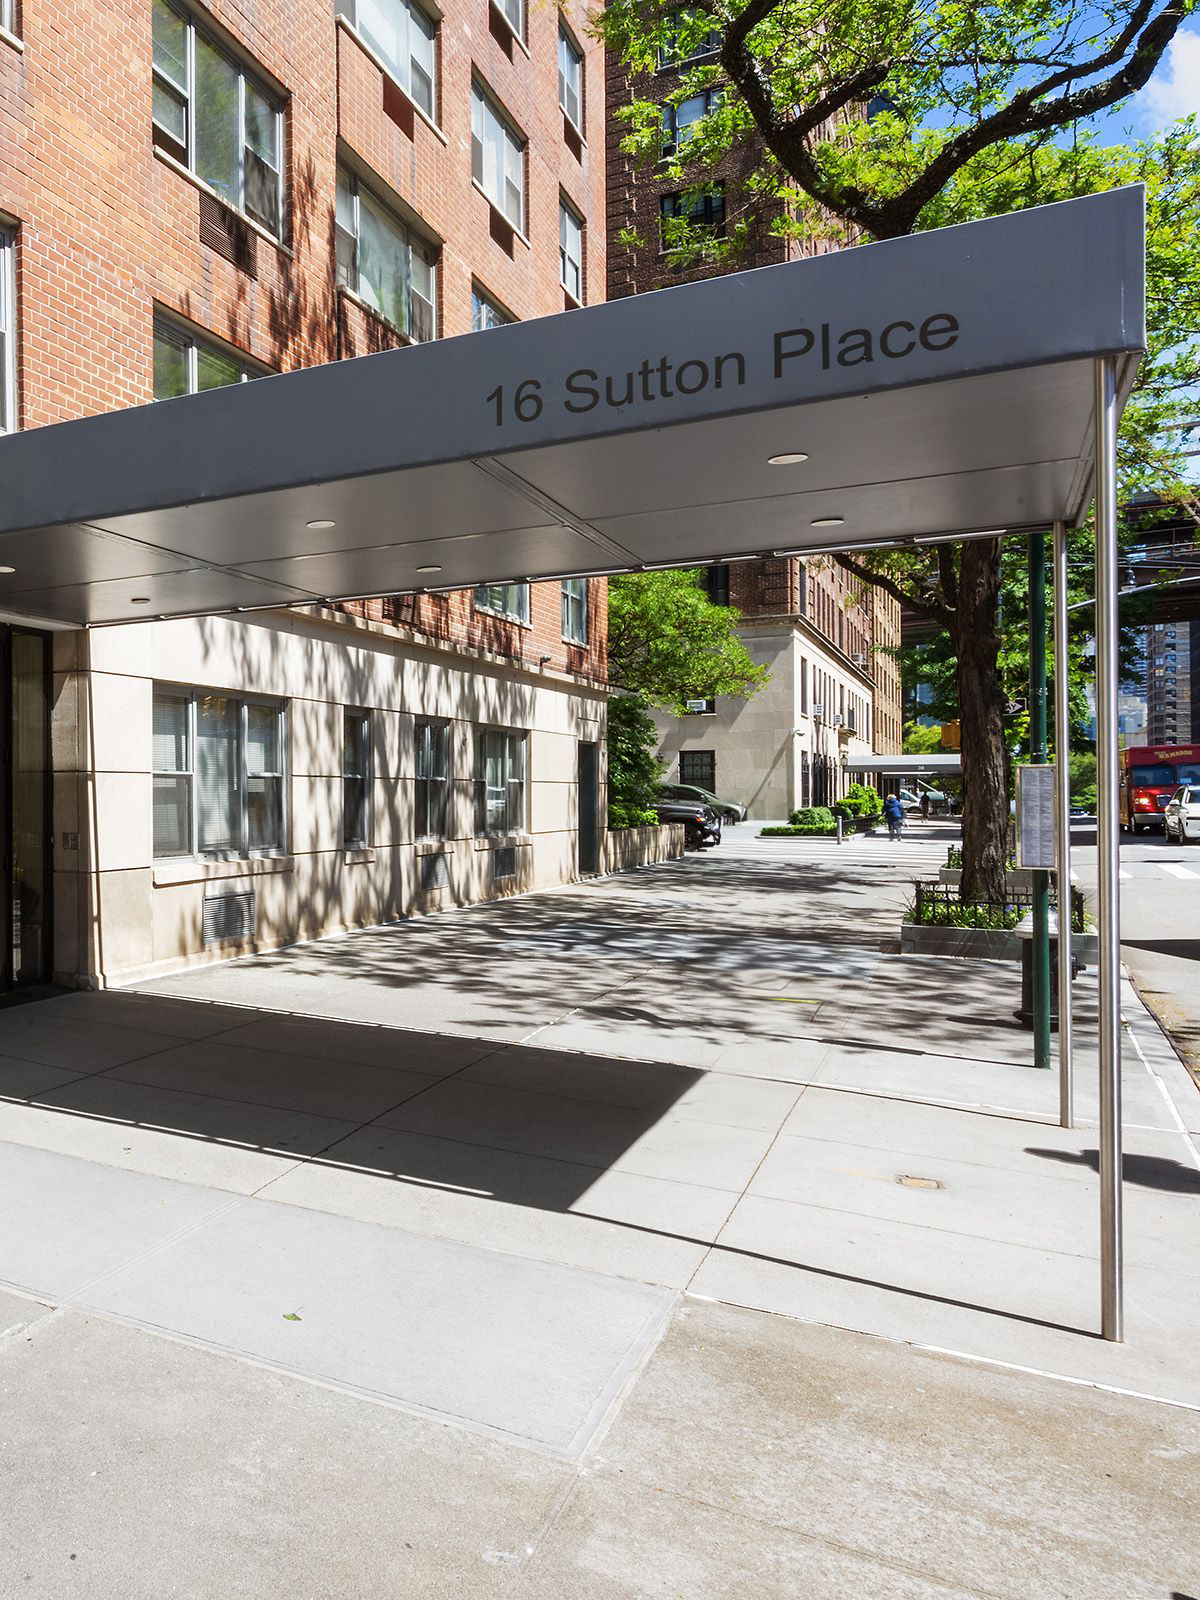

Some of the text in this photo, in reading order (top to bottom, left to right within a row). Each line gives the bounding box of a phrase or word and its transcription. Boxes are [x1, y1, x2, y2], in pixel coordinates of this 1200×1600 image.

[486, 313, 960, 427] 16 Sutton Place
